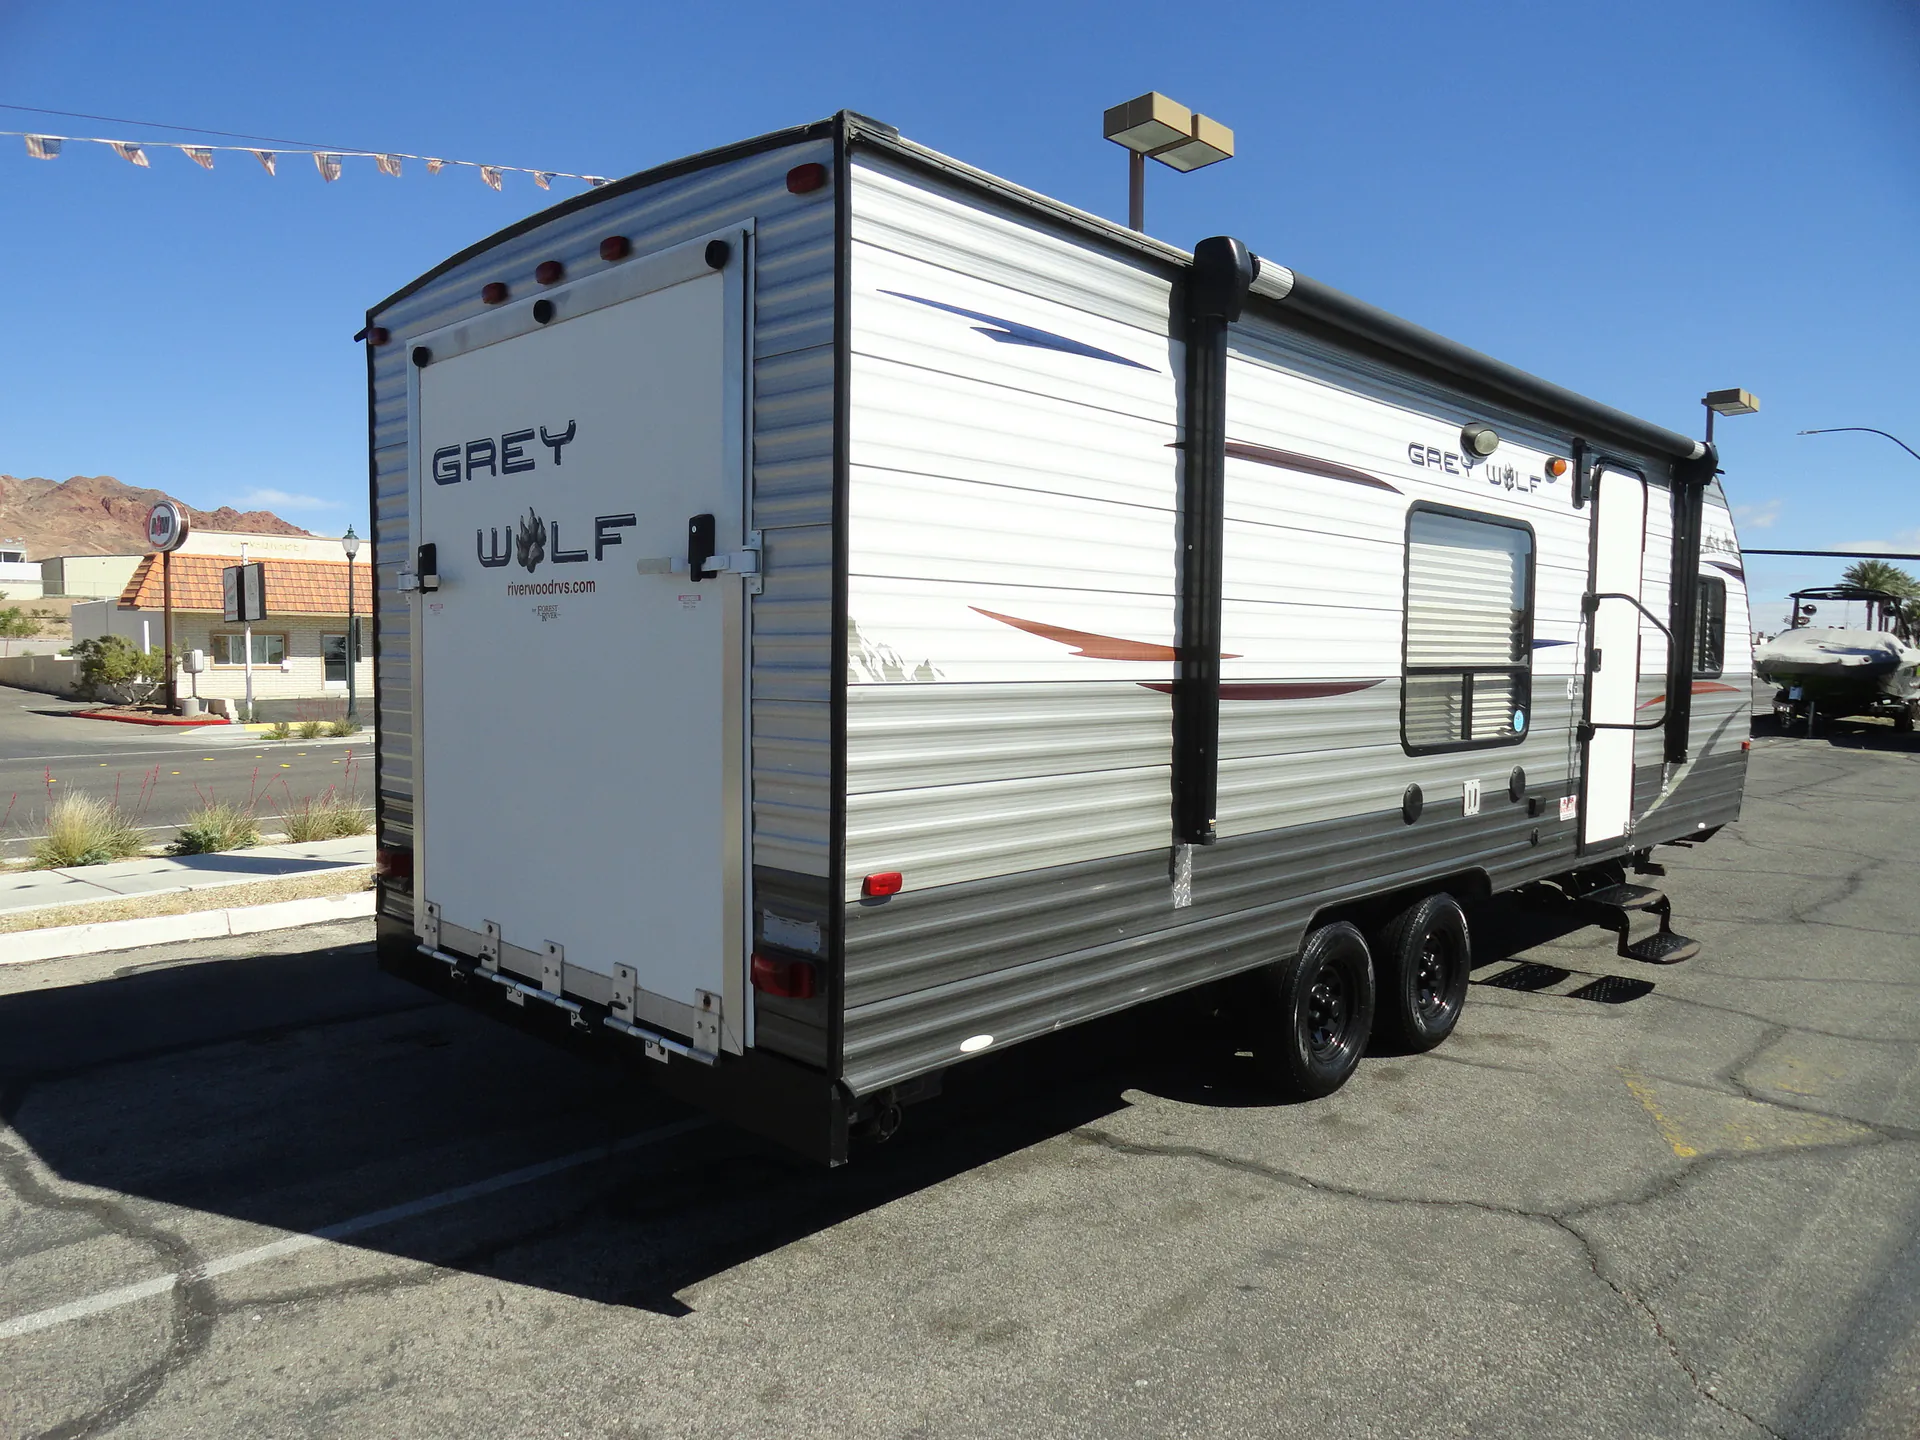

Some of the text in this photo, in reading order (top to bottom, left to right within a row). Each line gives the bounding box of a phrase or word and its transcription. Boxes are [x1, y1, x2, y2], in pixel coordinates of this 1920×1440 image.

[432, 419, 577, 486] GREY
[1408, 441, 1541, 493] GREY WOLF
[477, 507, 637, 574] WOLF
[507, 579, 596, 596] riverwoodrvs.com
